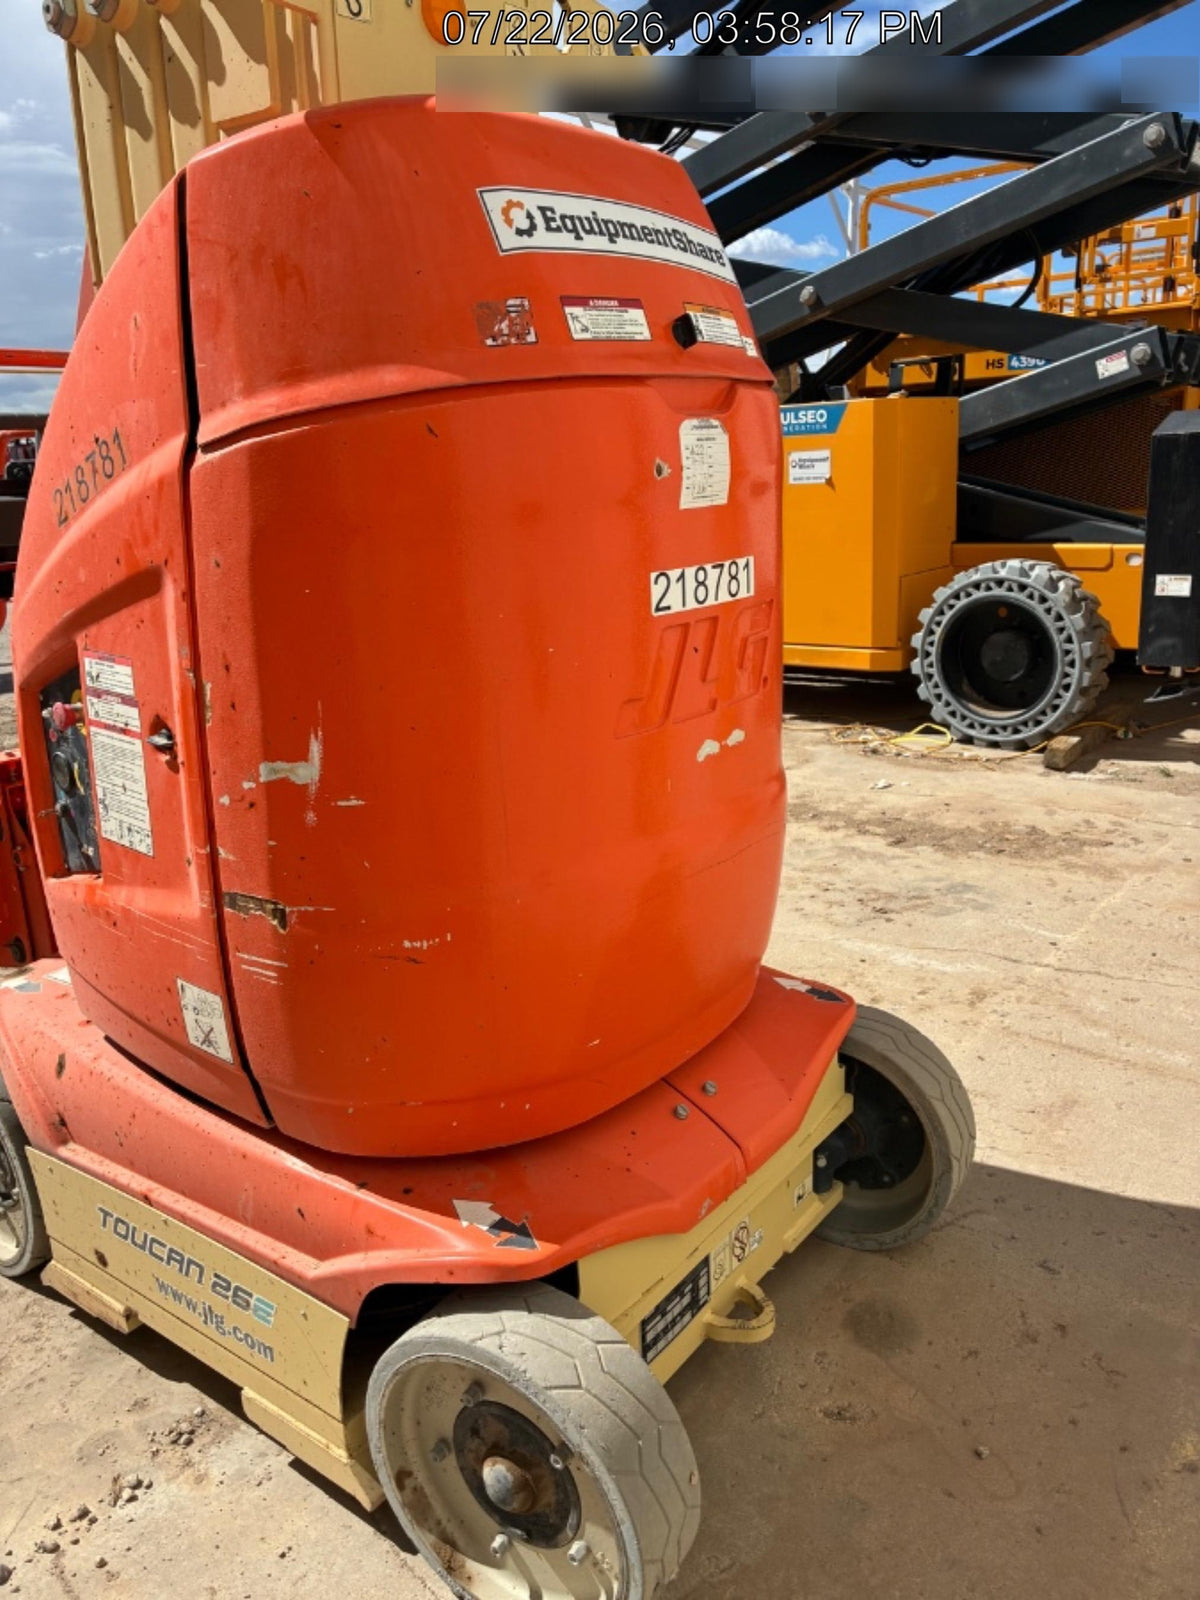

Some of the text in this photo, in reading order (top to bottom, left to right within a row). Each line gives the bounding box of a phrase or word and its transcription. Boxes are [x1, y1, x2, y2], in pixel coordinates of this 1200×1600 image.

[537, 205, 726, 267] EquipmentShare
[986, 358, 1004, 370] HS
[780, 409, 828, 424] ULSEO
[54, 427, 127, 528] 218781
[653, 556, 751, 613] 218781
[97, 1206, 277, 1327] TOUCAN 26E
[154, 1276, 274, 1363] www.jlg.com
